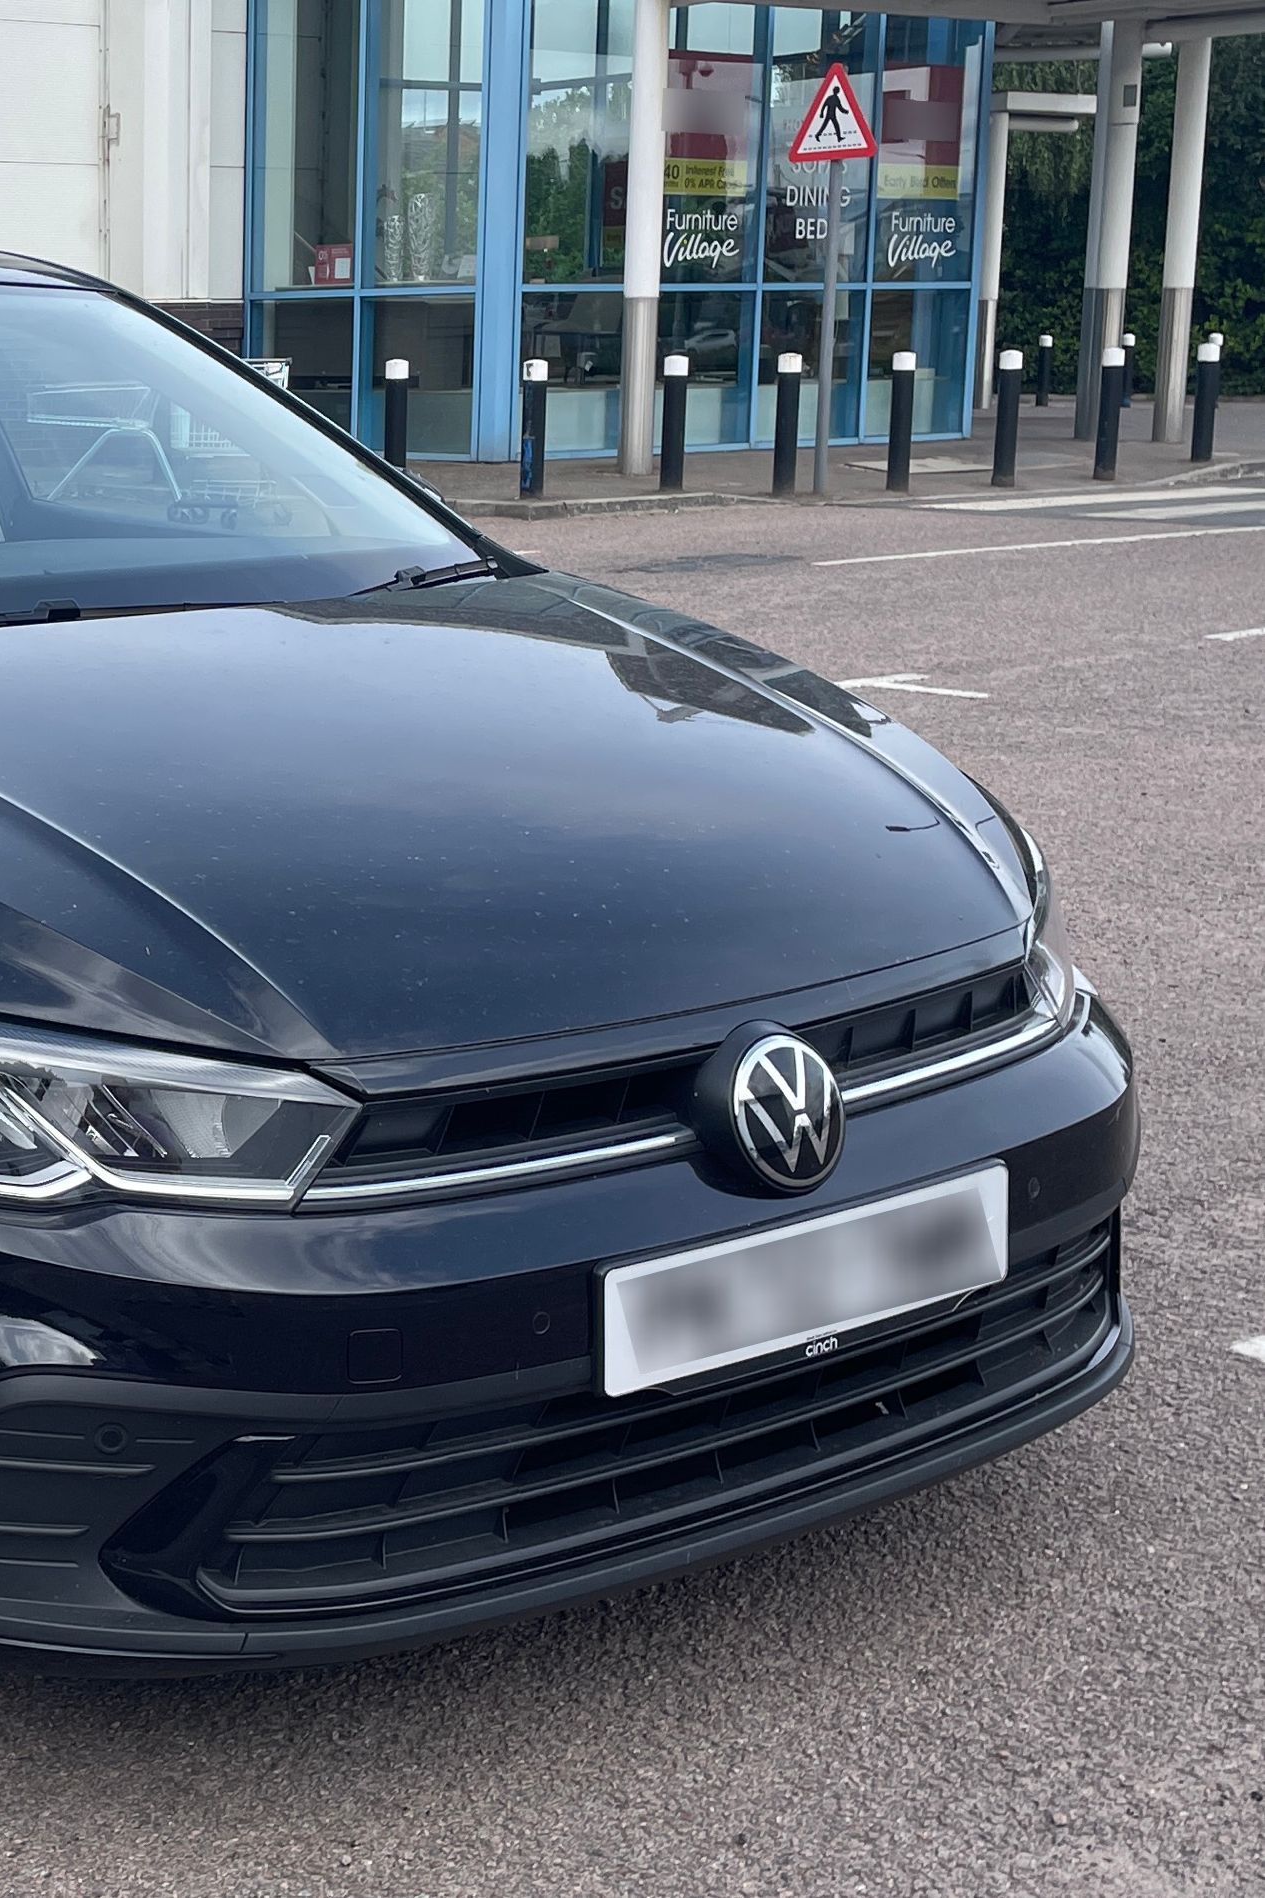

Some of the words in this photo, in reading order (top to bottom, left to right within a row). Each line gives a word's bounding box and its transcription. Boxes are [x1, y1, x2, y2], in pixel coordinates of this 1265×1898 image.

[666, 208, 738, 231] Furniture
[795, 217, 829, 239] BED
[891, 211, 956, 233] Furniture
[663, 231, 740, 268] Village
[887, 233, 956, 268] Village
[805, 1336, 839, 1358] cinch
